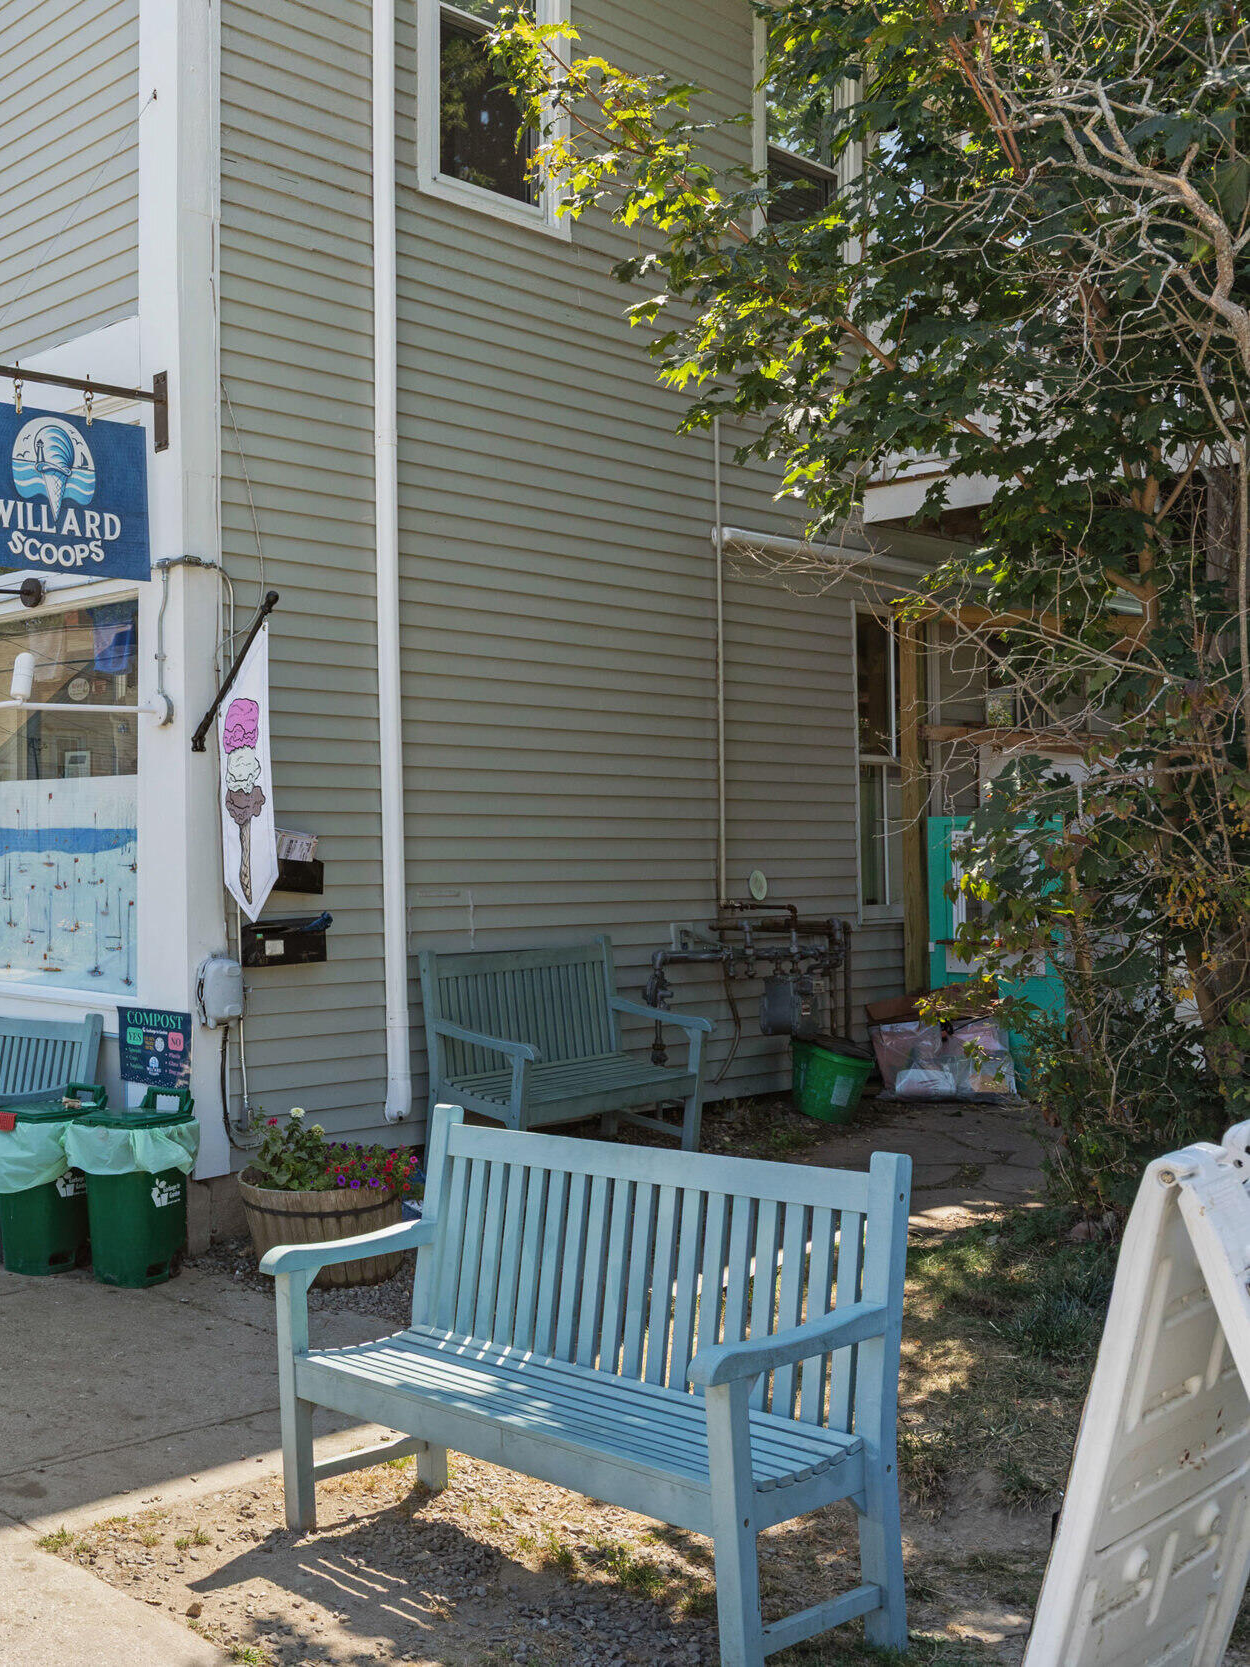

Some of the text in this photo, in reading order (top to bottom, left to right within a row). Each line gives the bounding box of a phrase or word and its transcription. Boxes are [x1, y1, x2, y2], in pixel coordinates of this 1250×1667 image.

[7, 530, 105, 568] SCOOPS
[126, 1010, 183, 1030] COMPOST
[128, 1031, 142, 1042] YES
[170, 1037, 182, 1048] NO
